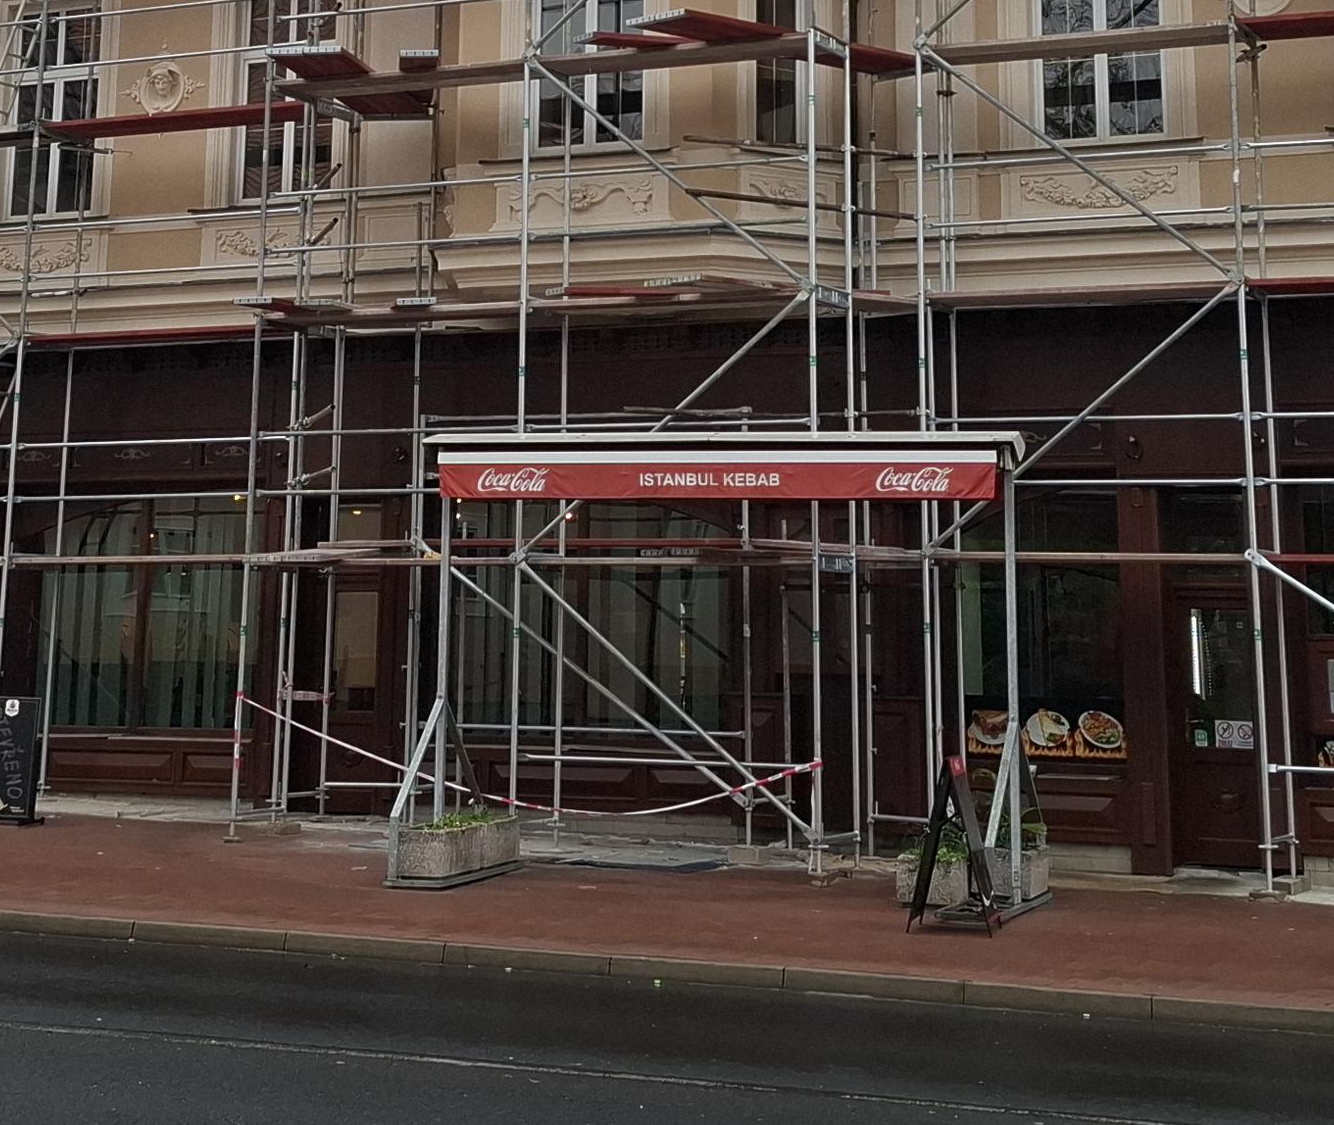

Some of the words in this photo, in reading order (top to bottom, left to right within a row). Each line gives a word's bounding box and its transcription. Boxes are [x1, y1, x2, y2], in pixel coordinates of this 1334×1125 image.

[478, 467, 550, 492] Coca-Cola
[639, 472, 719, 487] ISTANBUL
[723, 472, 780, 487] KEBAB
[876, 467, 954, 492] Coca-Cola
